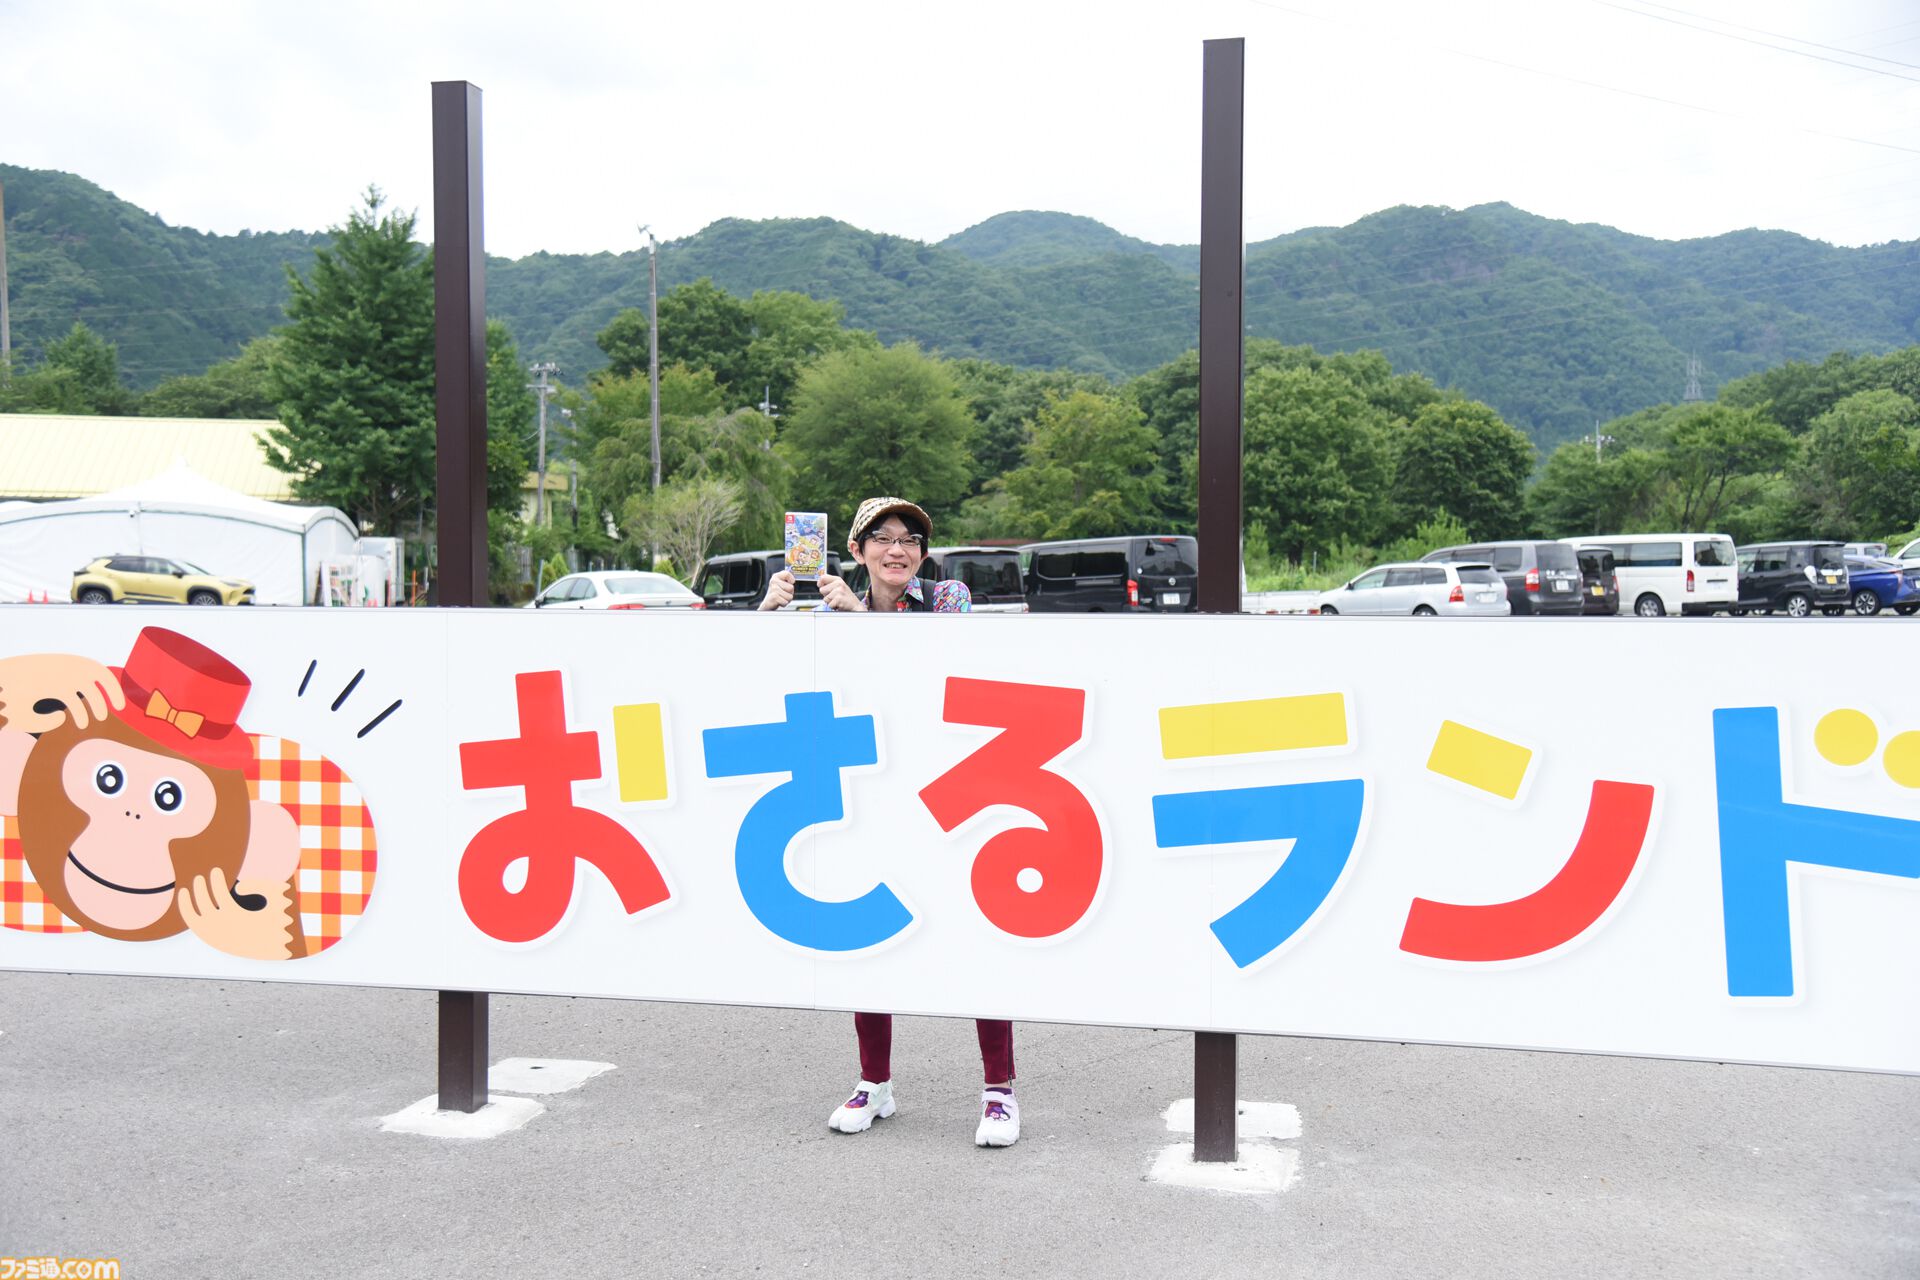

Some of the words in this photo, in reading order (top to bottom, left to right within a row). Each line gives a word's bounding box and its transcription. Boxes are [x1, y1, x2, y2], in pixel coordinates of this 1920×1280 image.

[458, 669, 1920, 997] おさるランド
